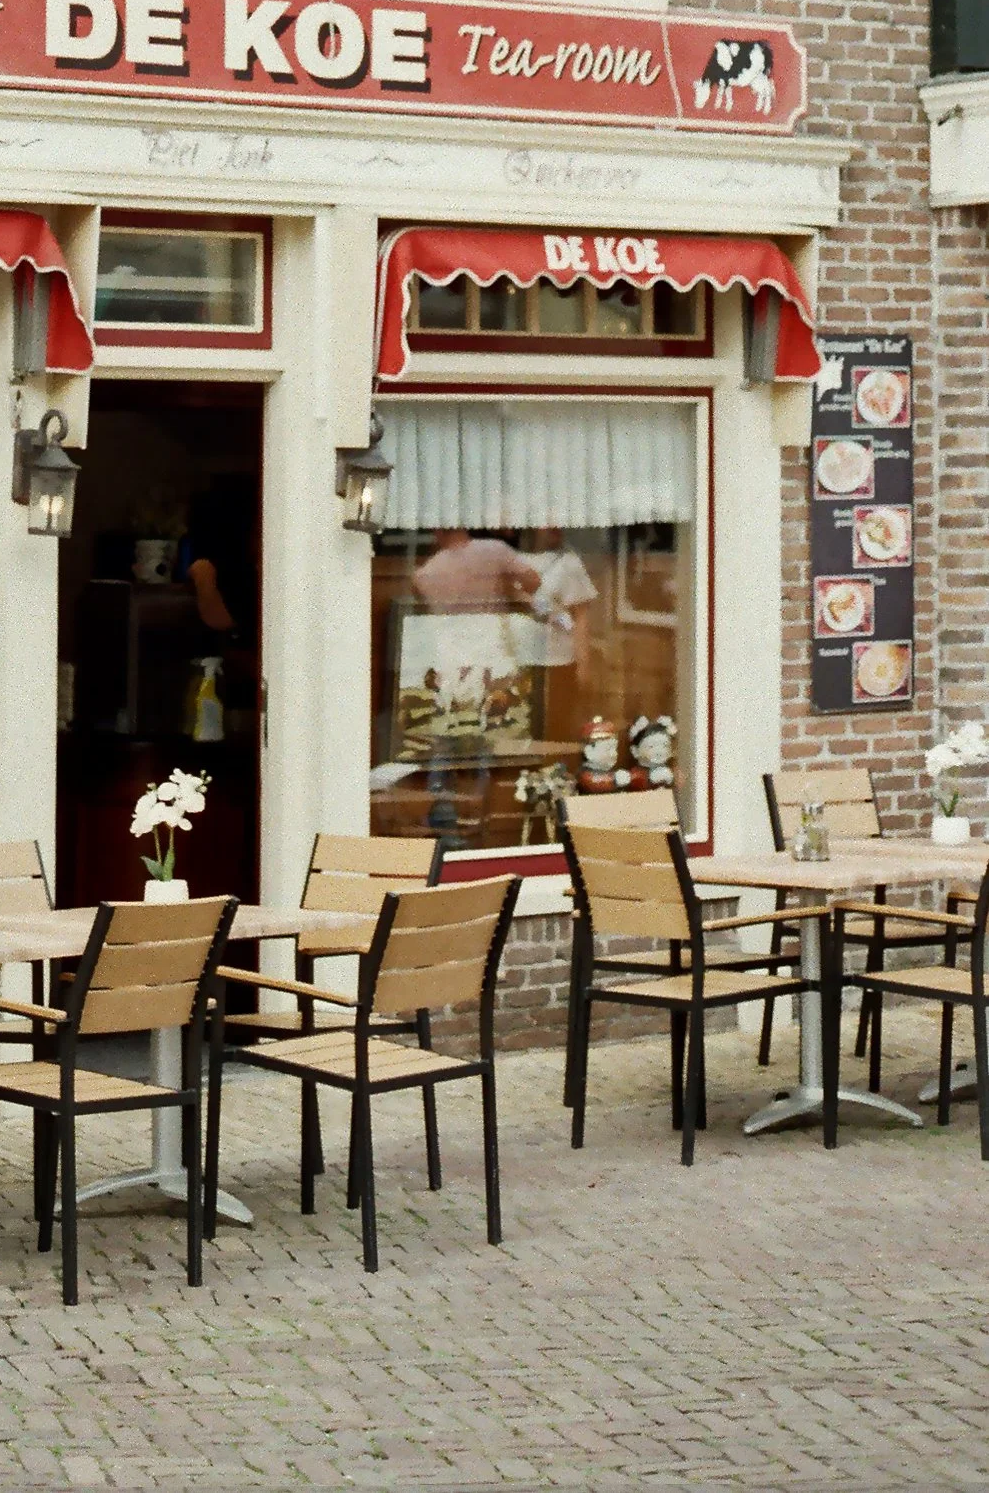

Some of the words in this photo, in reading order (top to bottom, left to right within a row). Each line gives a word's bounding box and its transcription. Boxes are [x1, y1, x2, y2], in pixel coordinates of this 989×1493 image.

[458, 24, 661, 86] Tea-room
[544, 234, 590, 271] DE
[593, 237, 666, 274] KOE
